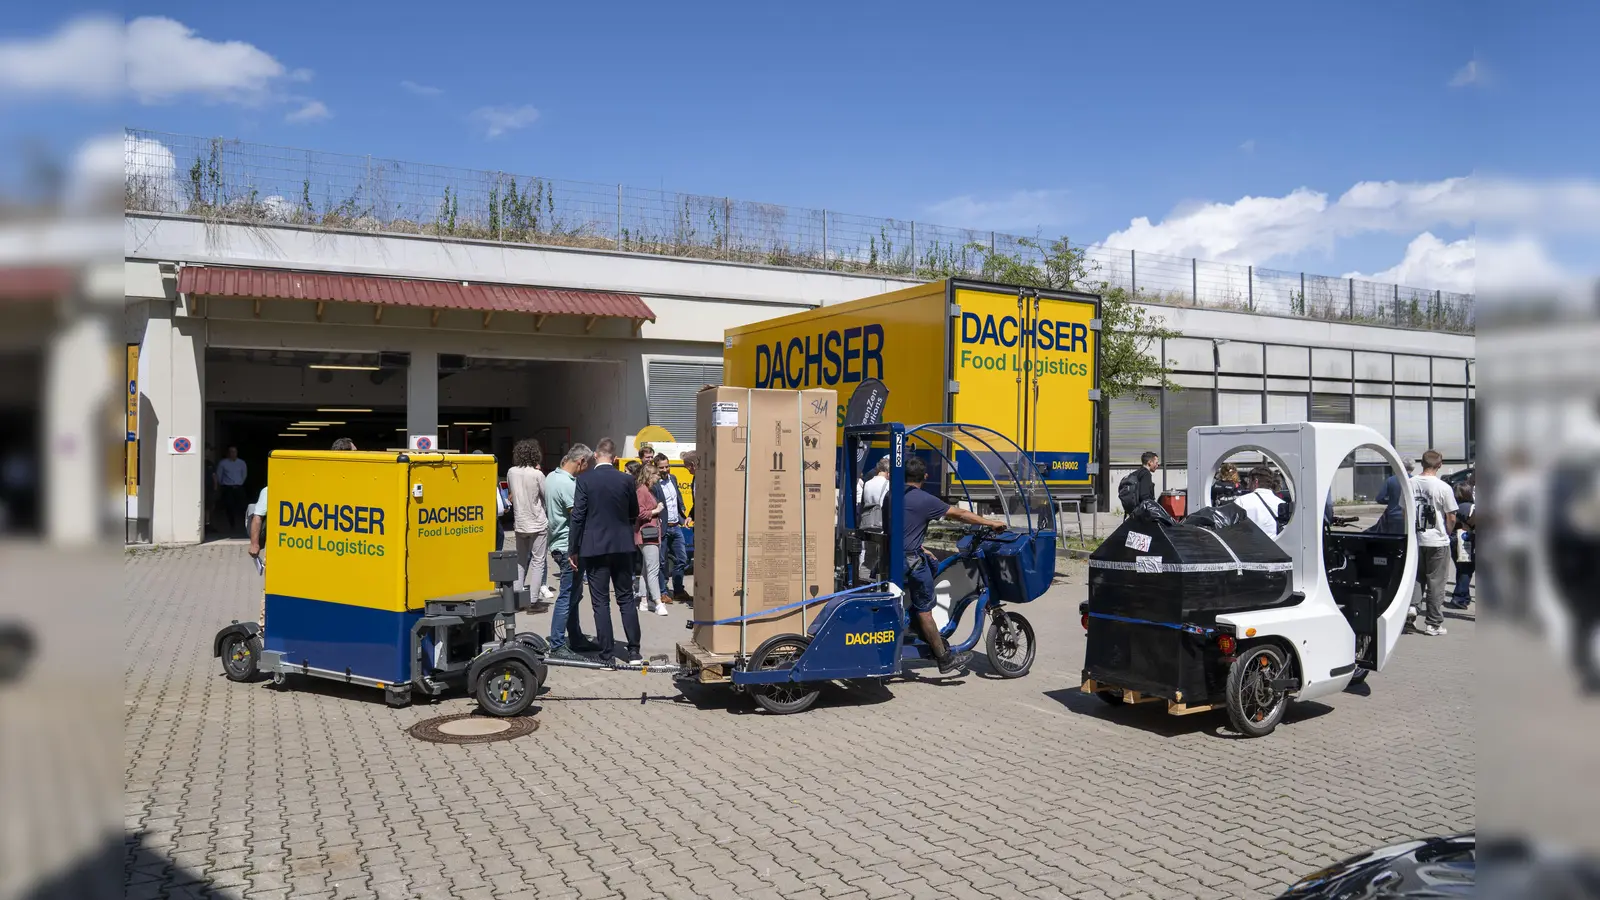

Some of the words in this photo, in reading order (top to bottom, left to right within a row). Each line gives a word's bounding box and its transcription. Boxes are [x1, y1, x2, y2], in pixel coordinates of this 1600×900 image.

[962, 312, 1088, 353] DACHSER
[755, 323, 885, 389] DACHSER
[961, 350, 1007, 371] Food
[1012, 353, 1088, 377] Logistics
[862, 388, 878, 425] eenZen
[869, 397, 883, 425] utions
[1052, 460, 1079, 470] DA19002
[279, 500, 385, 535] DACHSER
[418, 505, 484, 524] DACHSER
[278, 532, 313, 550] Food
[318, 535, 385, 557] Logistics
[418, 526, 442, 538] Food
[444, 524, 484, 537] Logistics
[845, 630, 895, 646] DACHSER
